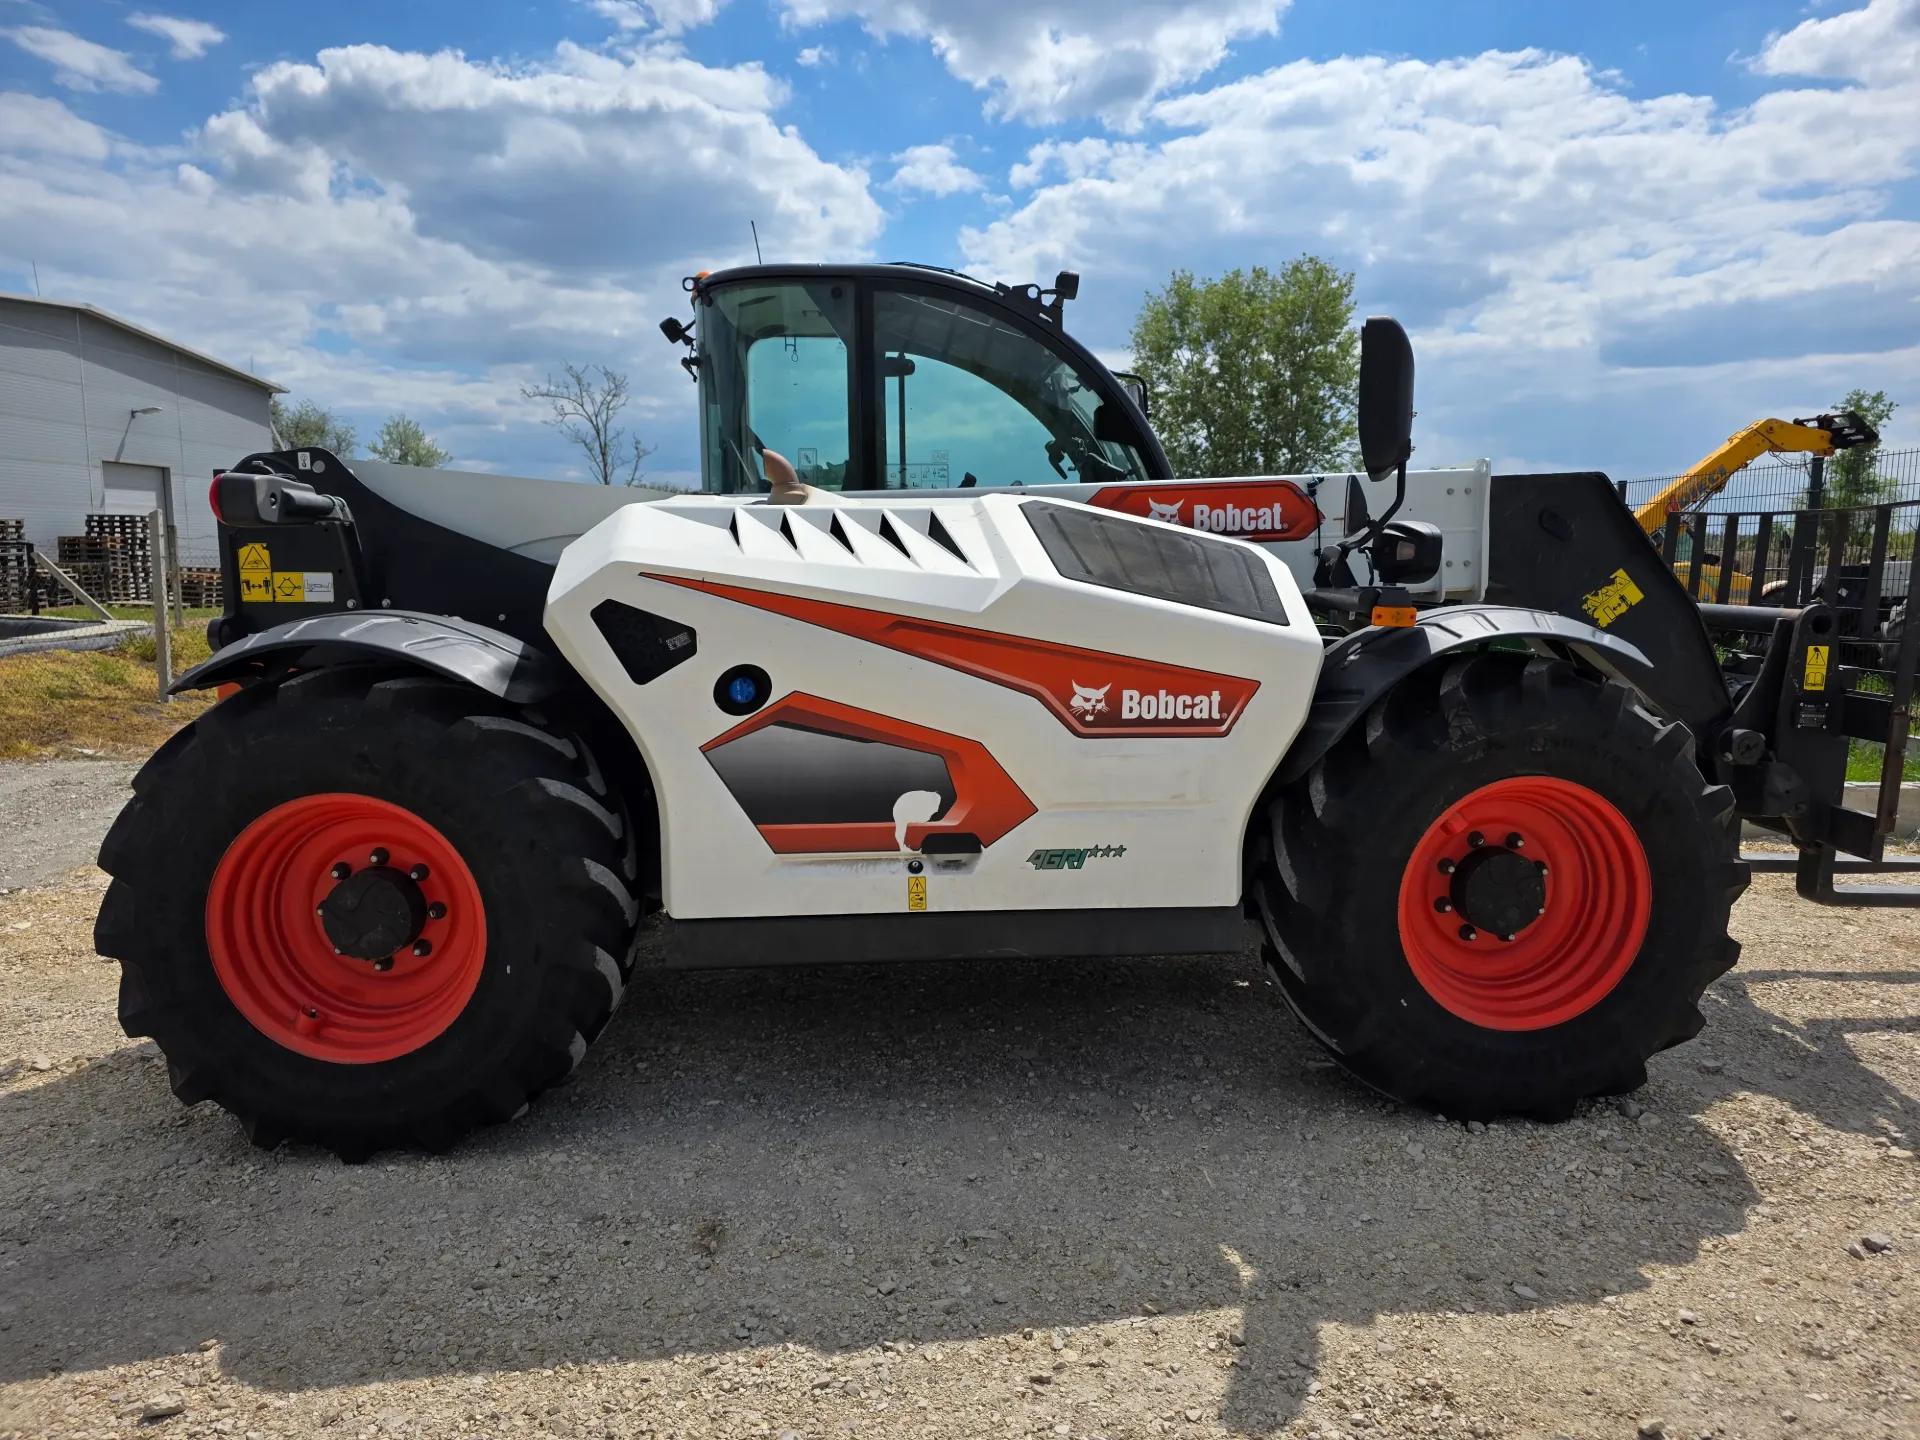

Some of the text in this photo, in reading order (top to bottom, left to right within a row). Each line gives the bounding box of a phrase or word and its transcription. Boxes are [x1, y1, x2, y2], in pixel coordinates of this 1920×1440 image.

[1193, 502, 1283, 532] Bobcat
[1121, 689, 1221, 720] Bobcat
[1026, 848, 1088, 870] AGRI
